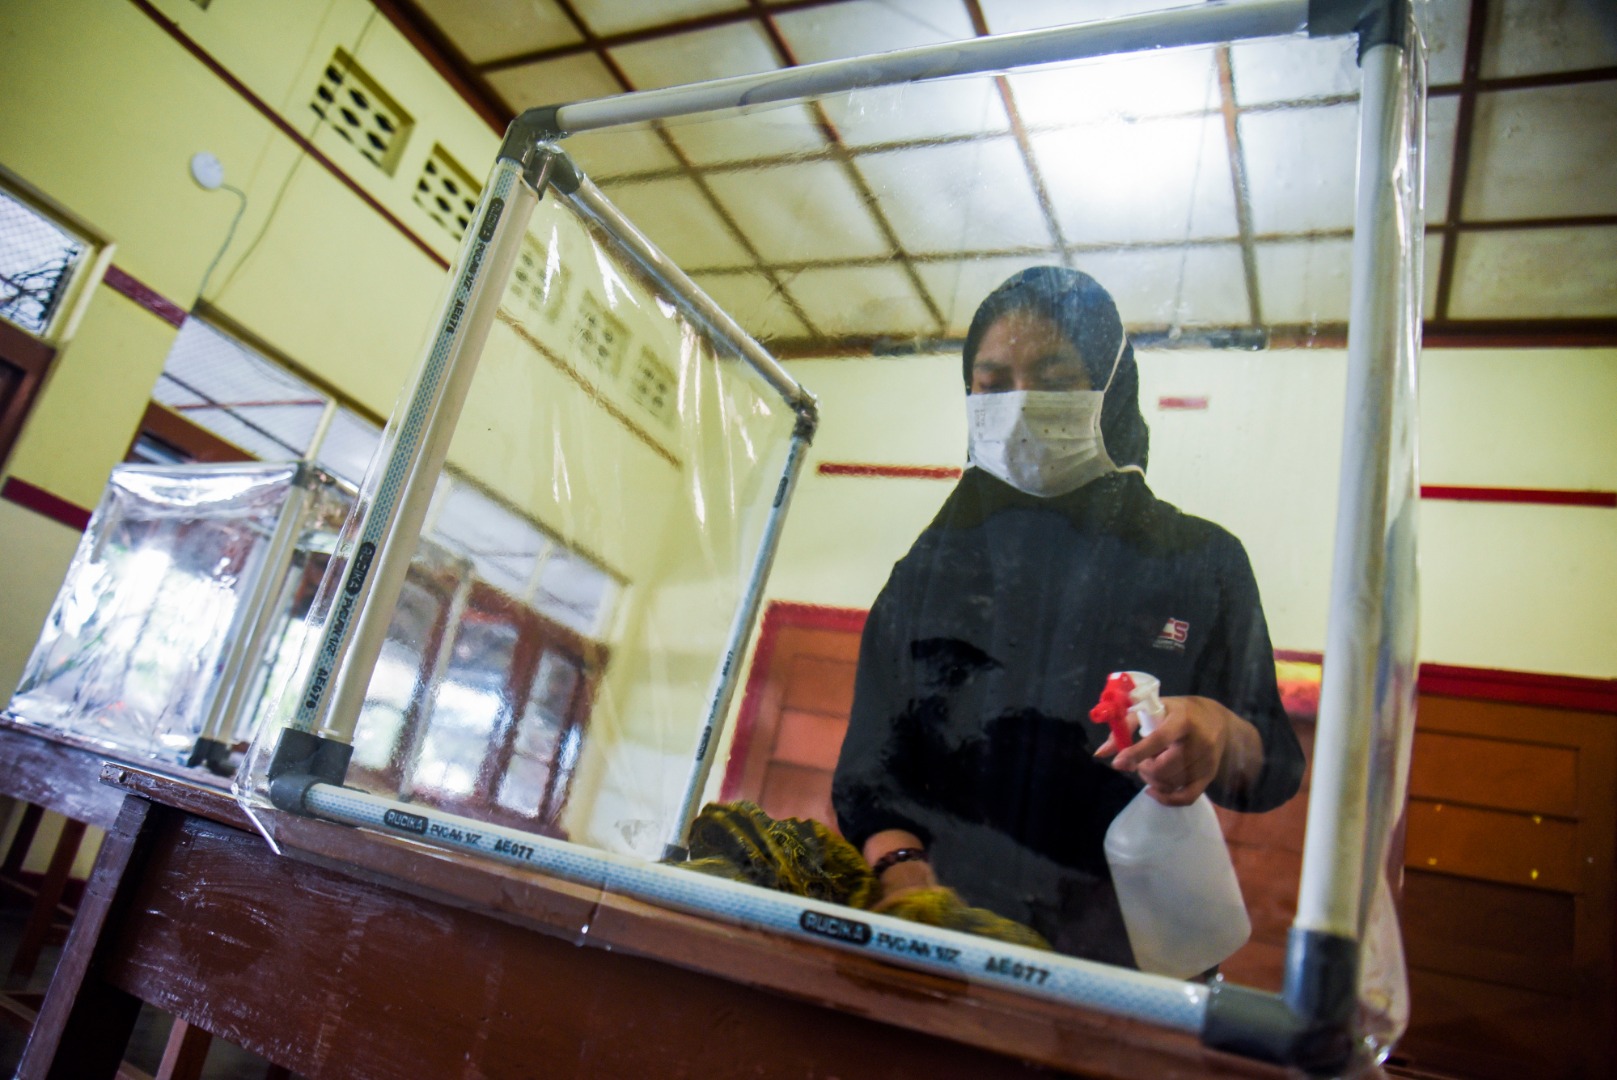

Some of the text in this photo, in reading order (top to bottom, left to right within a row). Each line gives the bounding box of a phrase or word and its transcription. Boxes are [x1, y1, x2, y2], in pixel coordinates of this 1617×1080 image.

[347, 544, 374, 591] RUCIKA
[386, 810, 425, 832] RUCIKA
[494, 839, 534, 860] AE077
[804, 912, 867, 941] RUCIKA
